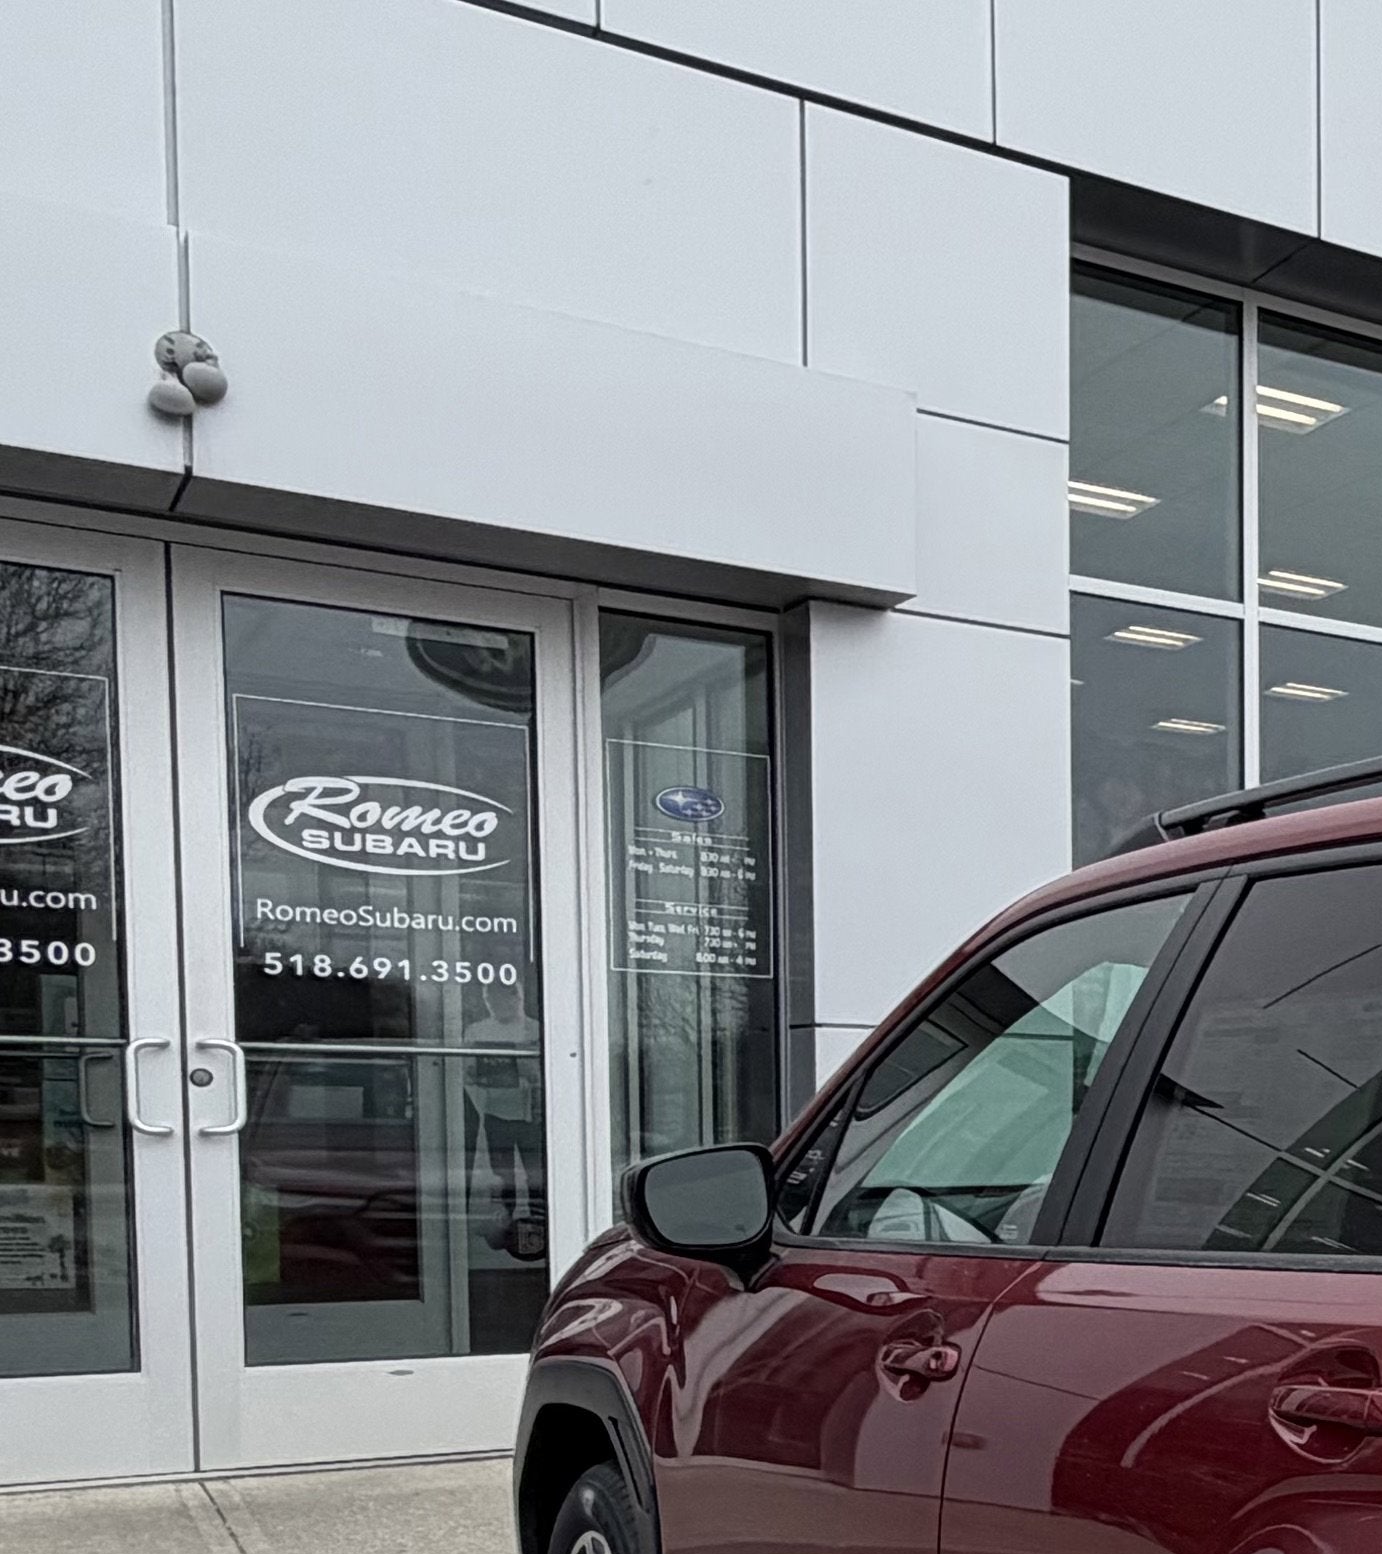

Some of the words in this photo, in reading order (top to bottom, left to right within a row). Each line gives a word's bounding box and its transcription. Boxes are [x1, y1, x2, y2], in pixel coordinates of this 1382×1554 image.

[284, 776, 498, 838] Romeo
[301, 829, 486, 861] SUBARU
[671, 831, 713, 846] Sales
[256, 898, 518, 933] RomeoSubaru.com
[664, 902, 718, 918] Service
[263, 952, 518, 986] 518.691.3500
